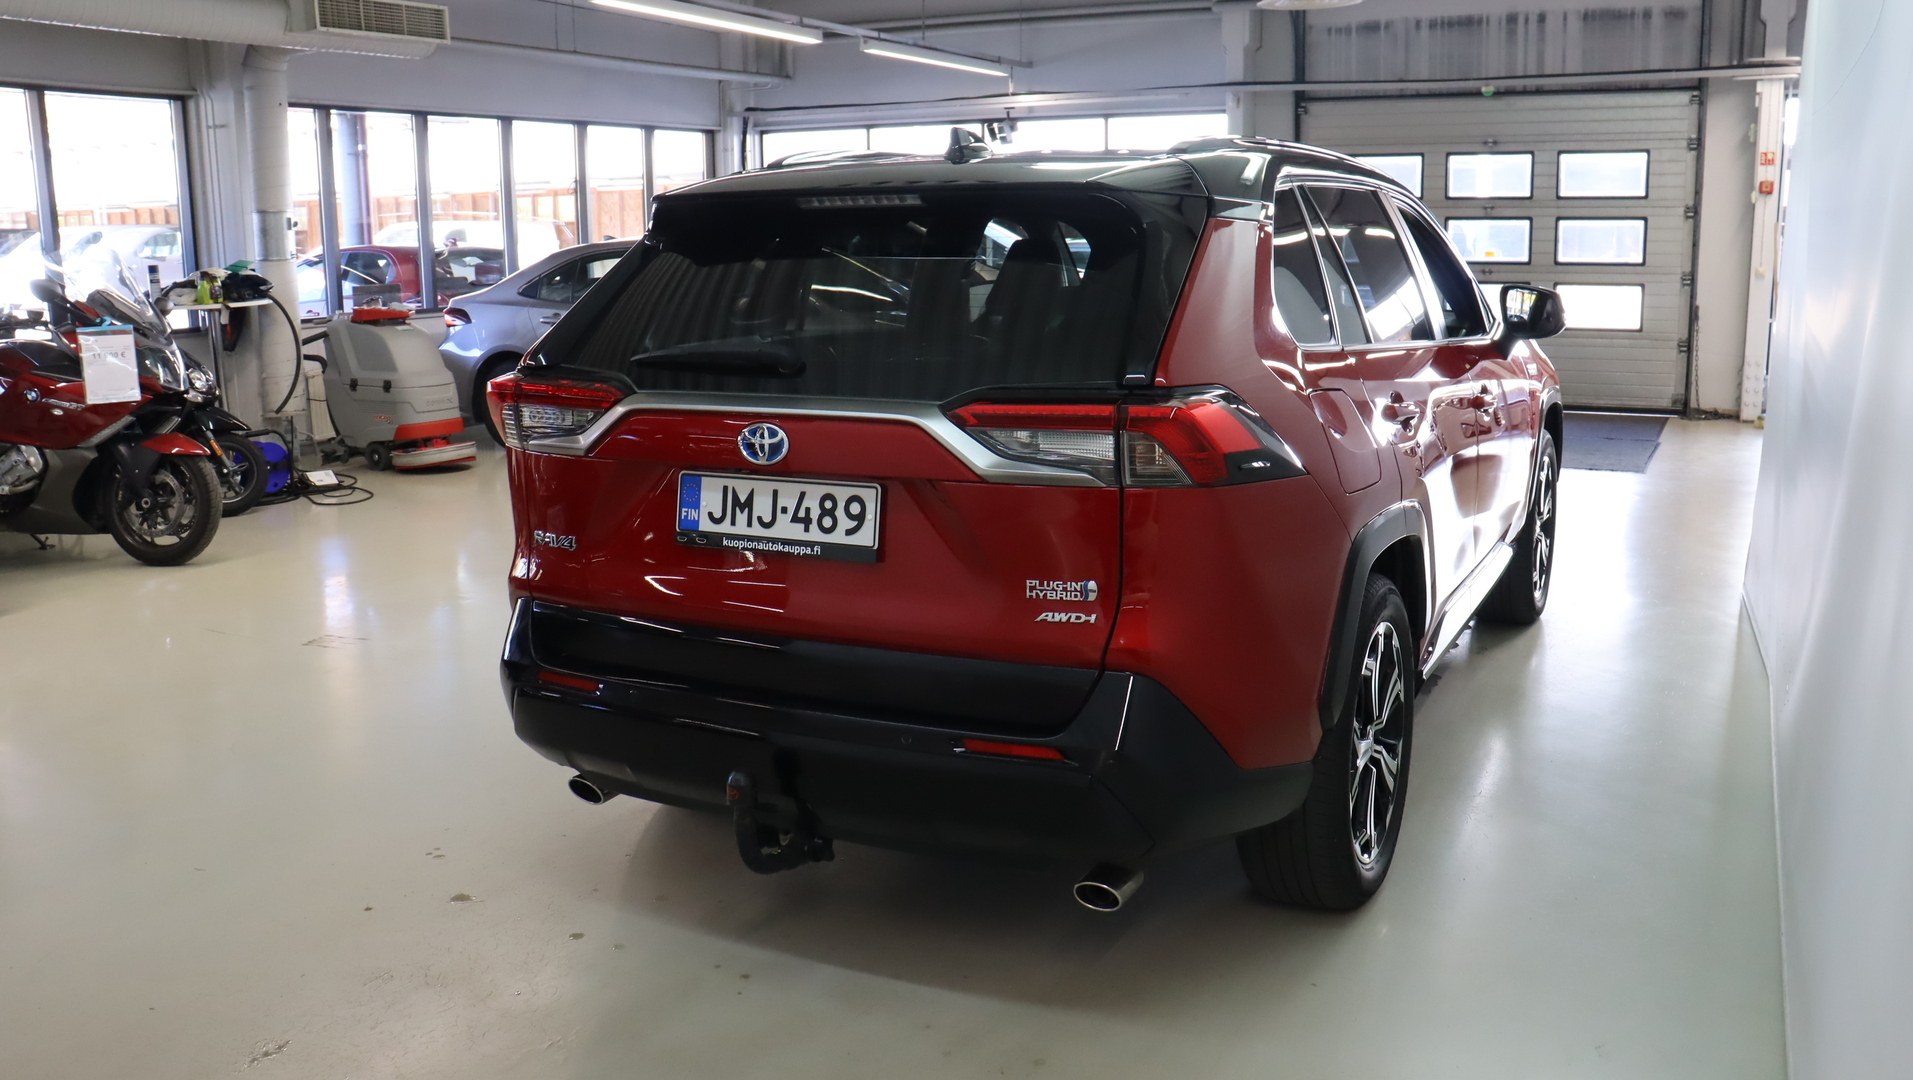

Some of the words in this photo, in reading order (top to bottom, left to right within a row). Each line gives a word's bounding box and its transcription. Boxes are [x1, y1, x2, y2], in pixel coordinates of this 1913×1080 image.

[681, 507, 699, 521] FIN
[707, 485, 867, 536] JMJ-489
[533, 529, 577, 552] RAV4
[722, 536, 821, 556] kuopionautokauppa.fi
[1026, 580, 1081, 591] PLUG-IN
[1026, 590, 1082, 600] HYBRID
